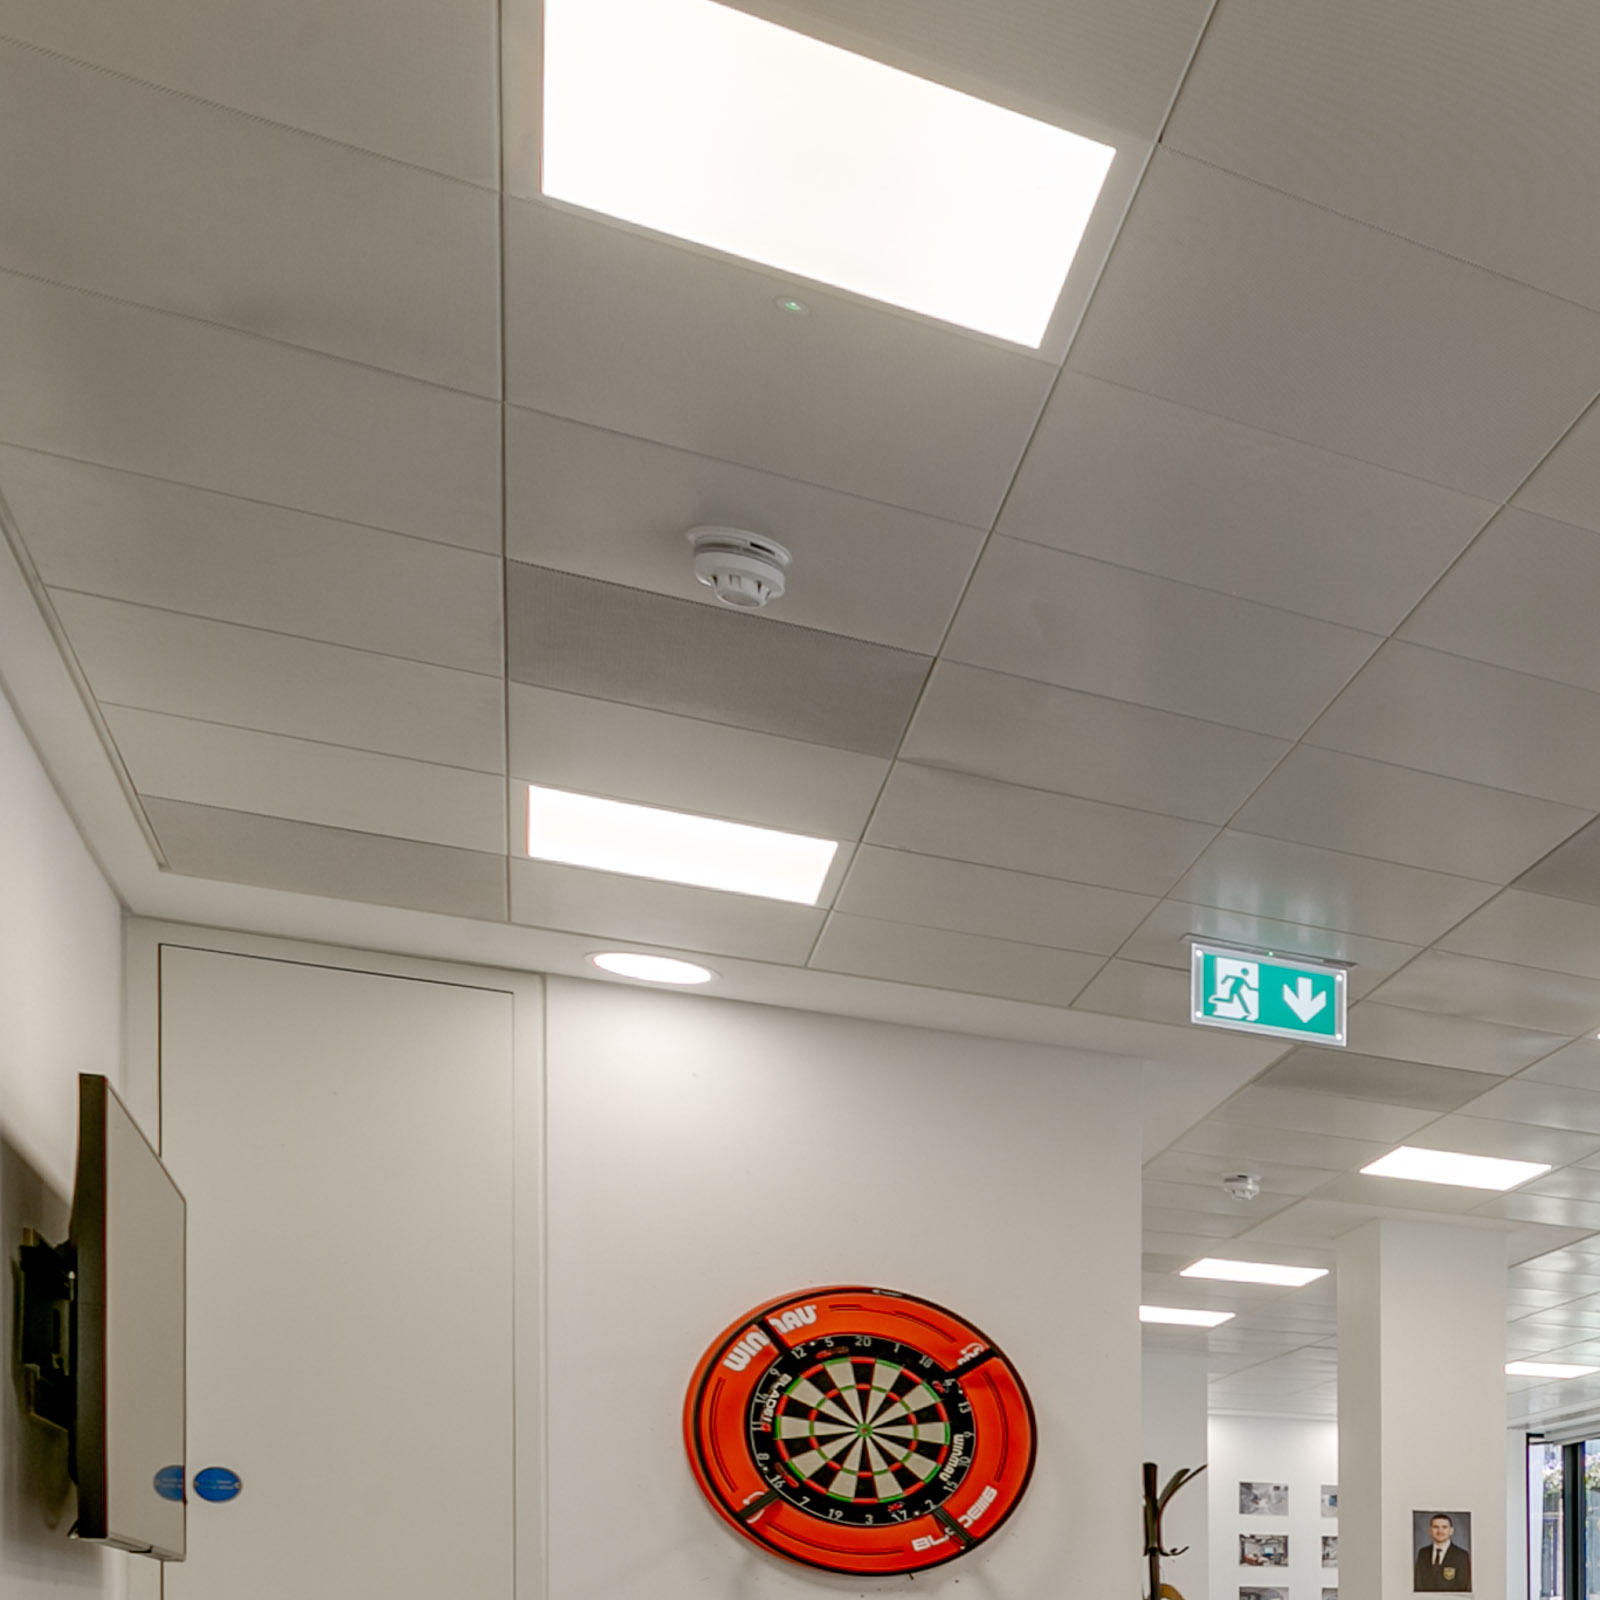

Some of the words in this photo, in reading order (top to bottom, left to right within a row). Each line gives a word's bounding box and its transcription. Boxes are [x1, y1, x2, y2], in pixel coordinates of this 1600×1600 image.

[824, 1338, 834, 1348] 5
[854, 1335, 872, 1347] 20
[791, 1346, 807, 1359] 12
[893, 1342, 900, 1353] 1
[918, 1354, 934, 1369] 18
[957, 1401, 972, 1414] 13
[757, 1452, 770, 1461] 8
[769, 1474, 786, 1489] 16
[943, 1480, 958, 1493] 15
[799, 1495, 811, 1507] 7
[924, 1499, 937, 1510] 2
[827, 1508, 844, 1521] 19
[864, 1514, 874, 1525] 3
[891, 1510, 908, 1522] 17
